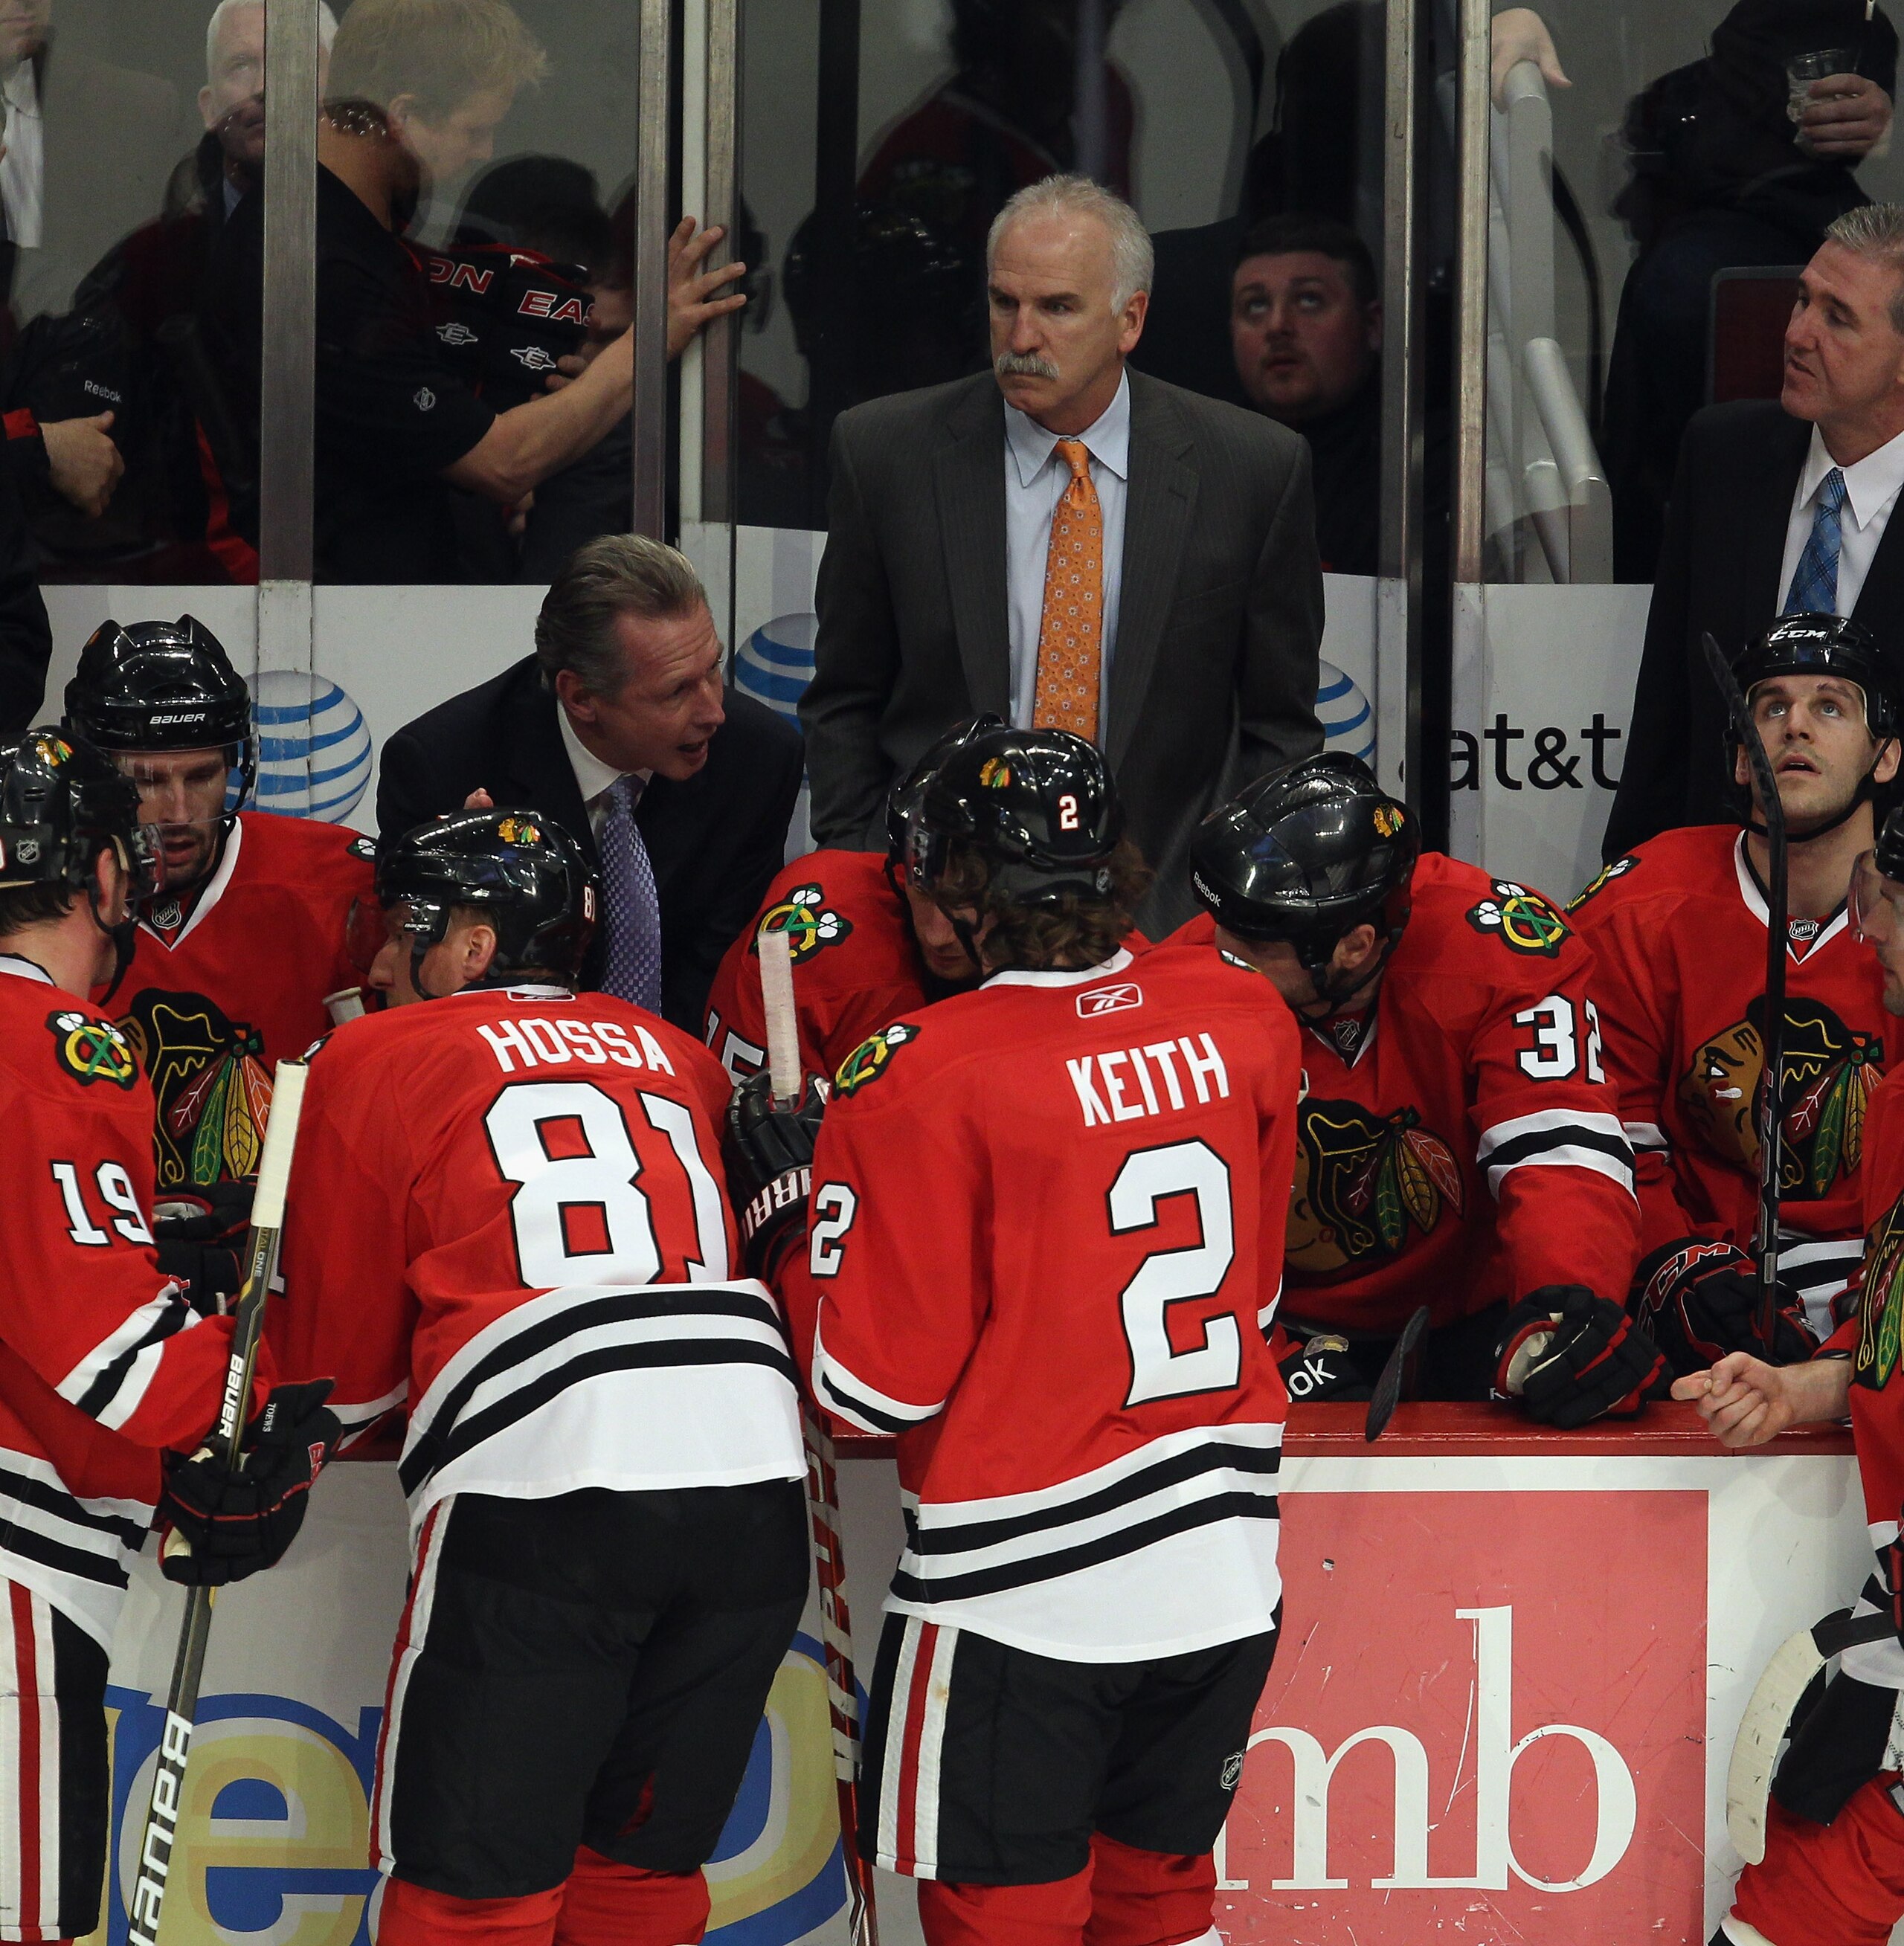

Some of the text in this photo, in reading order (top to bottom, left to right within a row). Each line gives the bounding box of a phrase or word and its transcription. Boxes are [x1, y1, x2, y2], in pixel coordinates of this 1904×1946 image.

[83, 379, 123, 403] Reebok
[1769, 628, 1827, 642] CCM
[1450, 712, 1621, 791] at&t
[1058, 795, 1078, 830] 2
[1193, 871, 1222, 907] Reebok
[475, 1017, 675, 1077] HOSSA
[1512, 993, 1606, 1085] 32
[1065, 1032, 1229, 1127] KEITH
[50, 1159, 156, 1247] 19
[481, 1080, 729, 1289] 81
[741, 1167, 812, 1240] RRI
[254, 1251, 266, 1278] ONE
[809, 1180, 859, 1279] 2
[1105, 1135, 1240, 1411] 2
[1286, 1358, 1337, 1402] ok
[262, 1402, 277, 1432] TOEWS
[129, 1710, 193, 1946] BAUE
